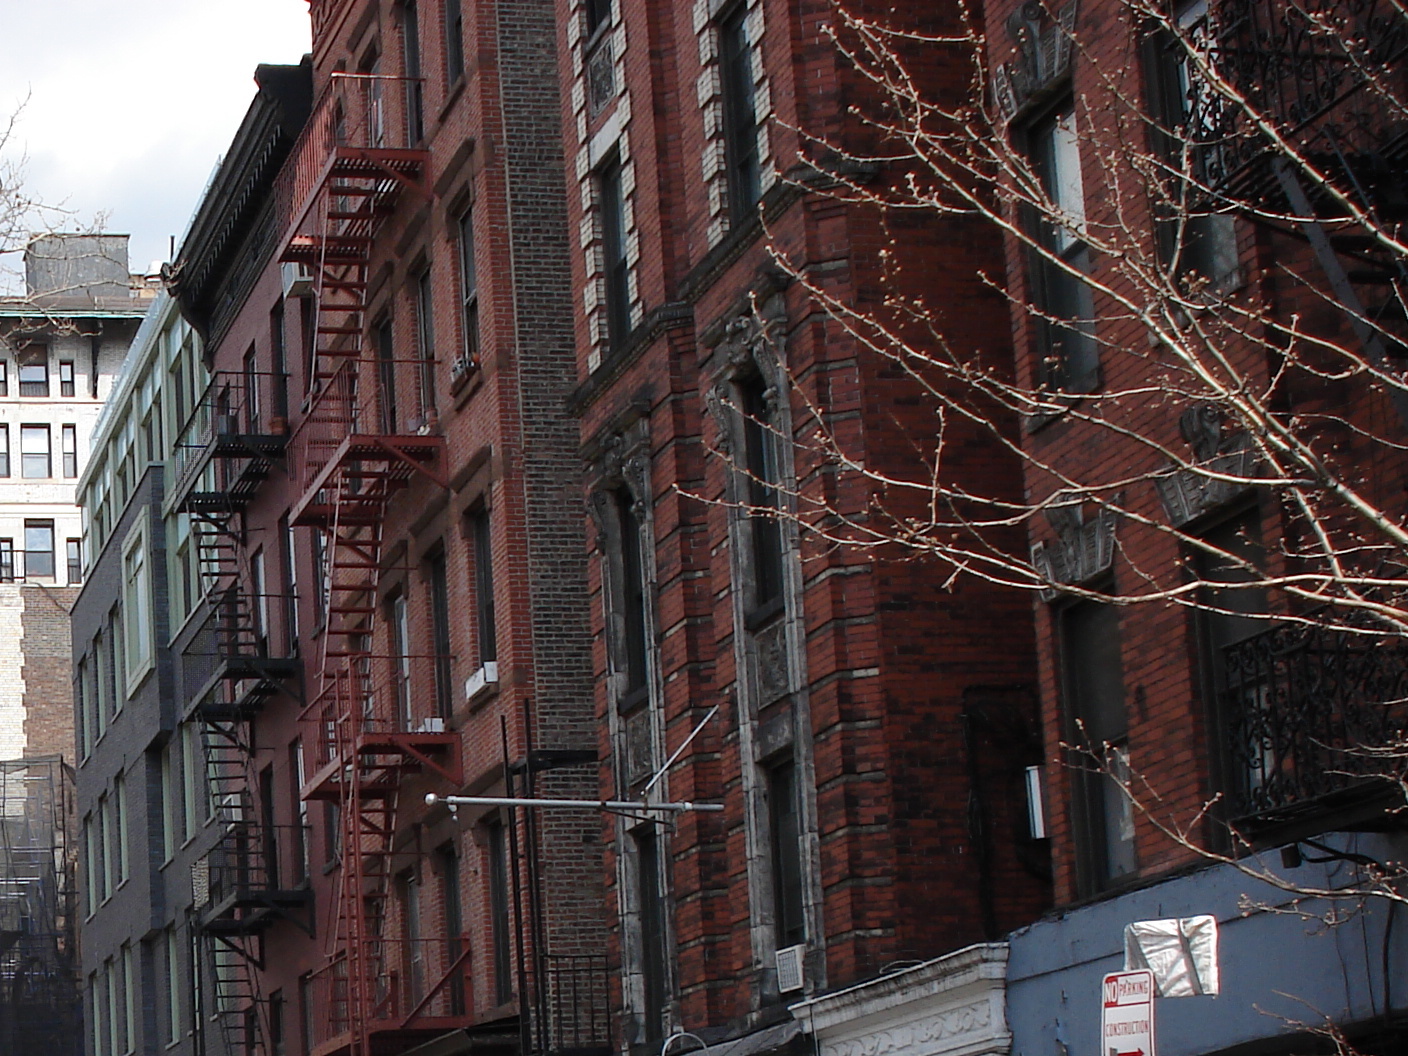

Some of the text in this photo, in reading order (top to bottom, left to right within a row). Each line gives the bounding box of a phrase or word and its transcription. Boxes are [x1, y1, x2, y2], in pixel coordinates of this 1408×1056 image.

[1104, 980, 1148, 1003] NO PARKING
[1105, 1020, 1149, 1037] CONSTRUCTION
